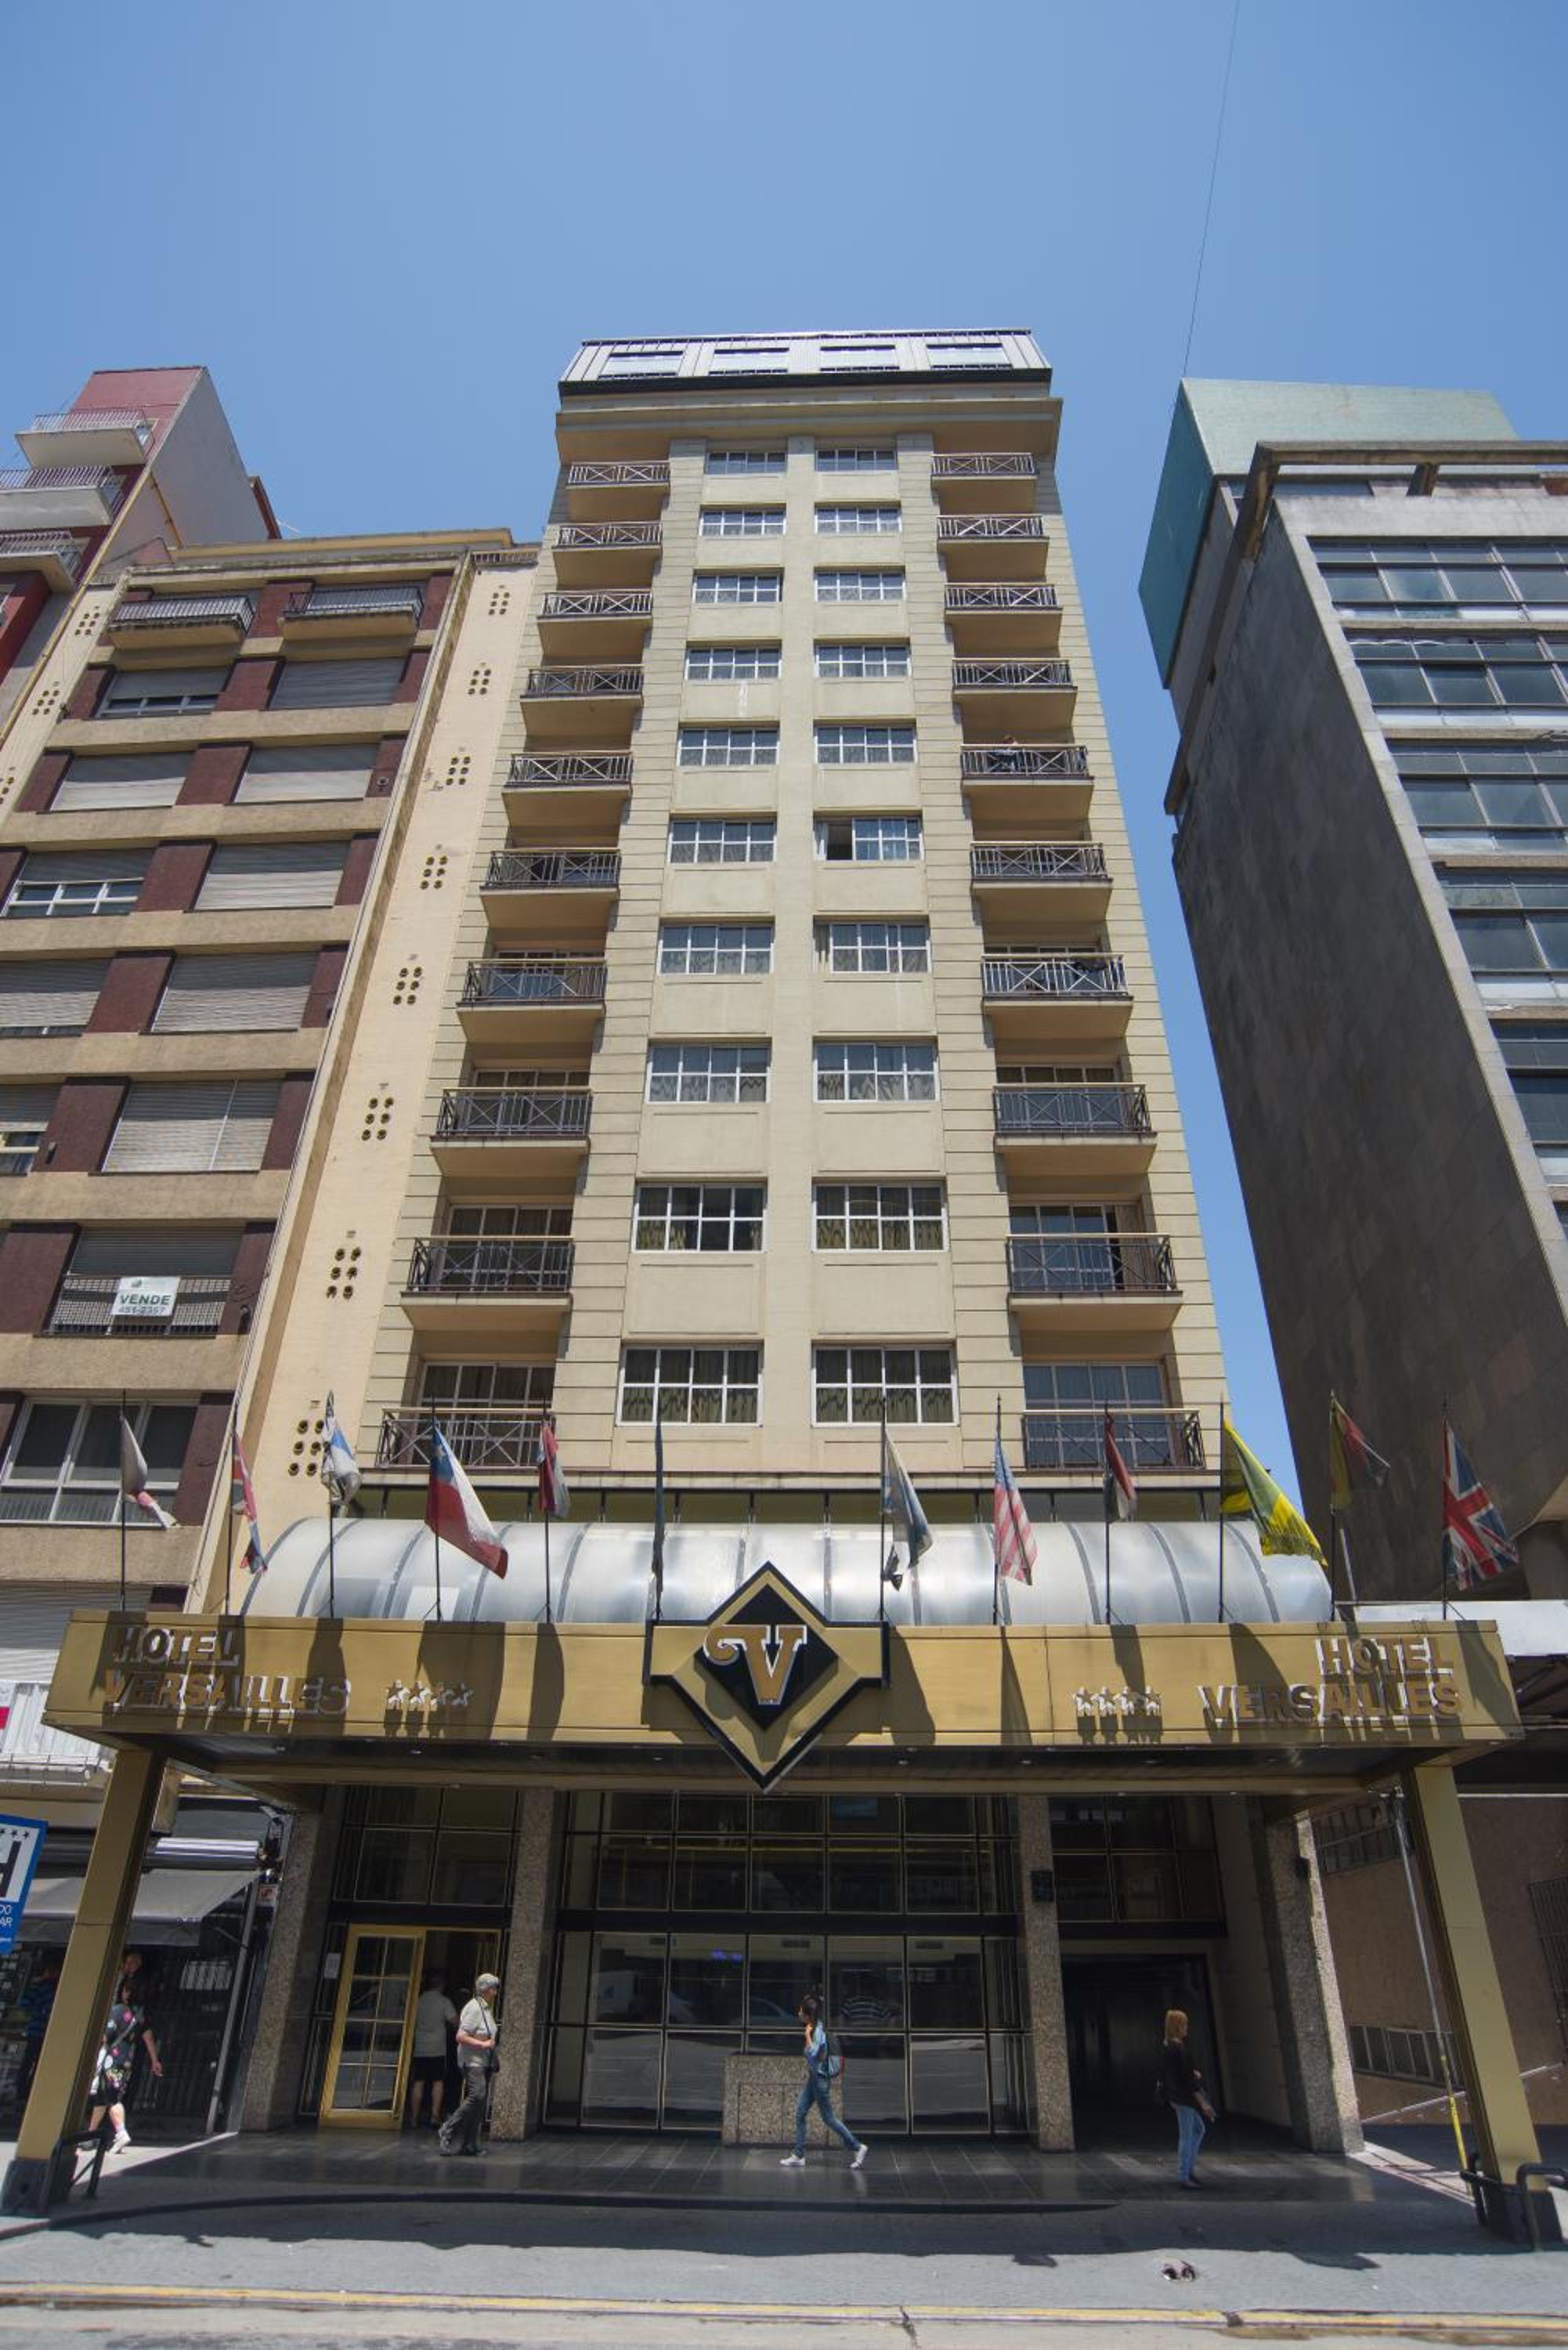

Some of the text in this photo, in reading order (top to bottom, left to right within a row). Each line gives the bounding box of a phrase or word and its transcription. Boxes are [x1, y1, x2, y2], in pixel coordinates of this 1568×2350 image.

[120, 1294, 171, 1305] VENDE
[114, 1627, 240, 1667] HOTEL
[703, 1624, 807, 1705] V
[1316, 1636, 1454, 1678] HOTEL
[106, 1668, 352, 1716] VERSAILLES
[1198, 1683, 1464, 1721] VERSAILLES
